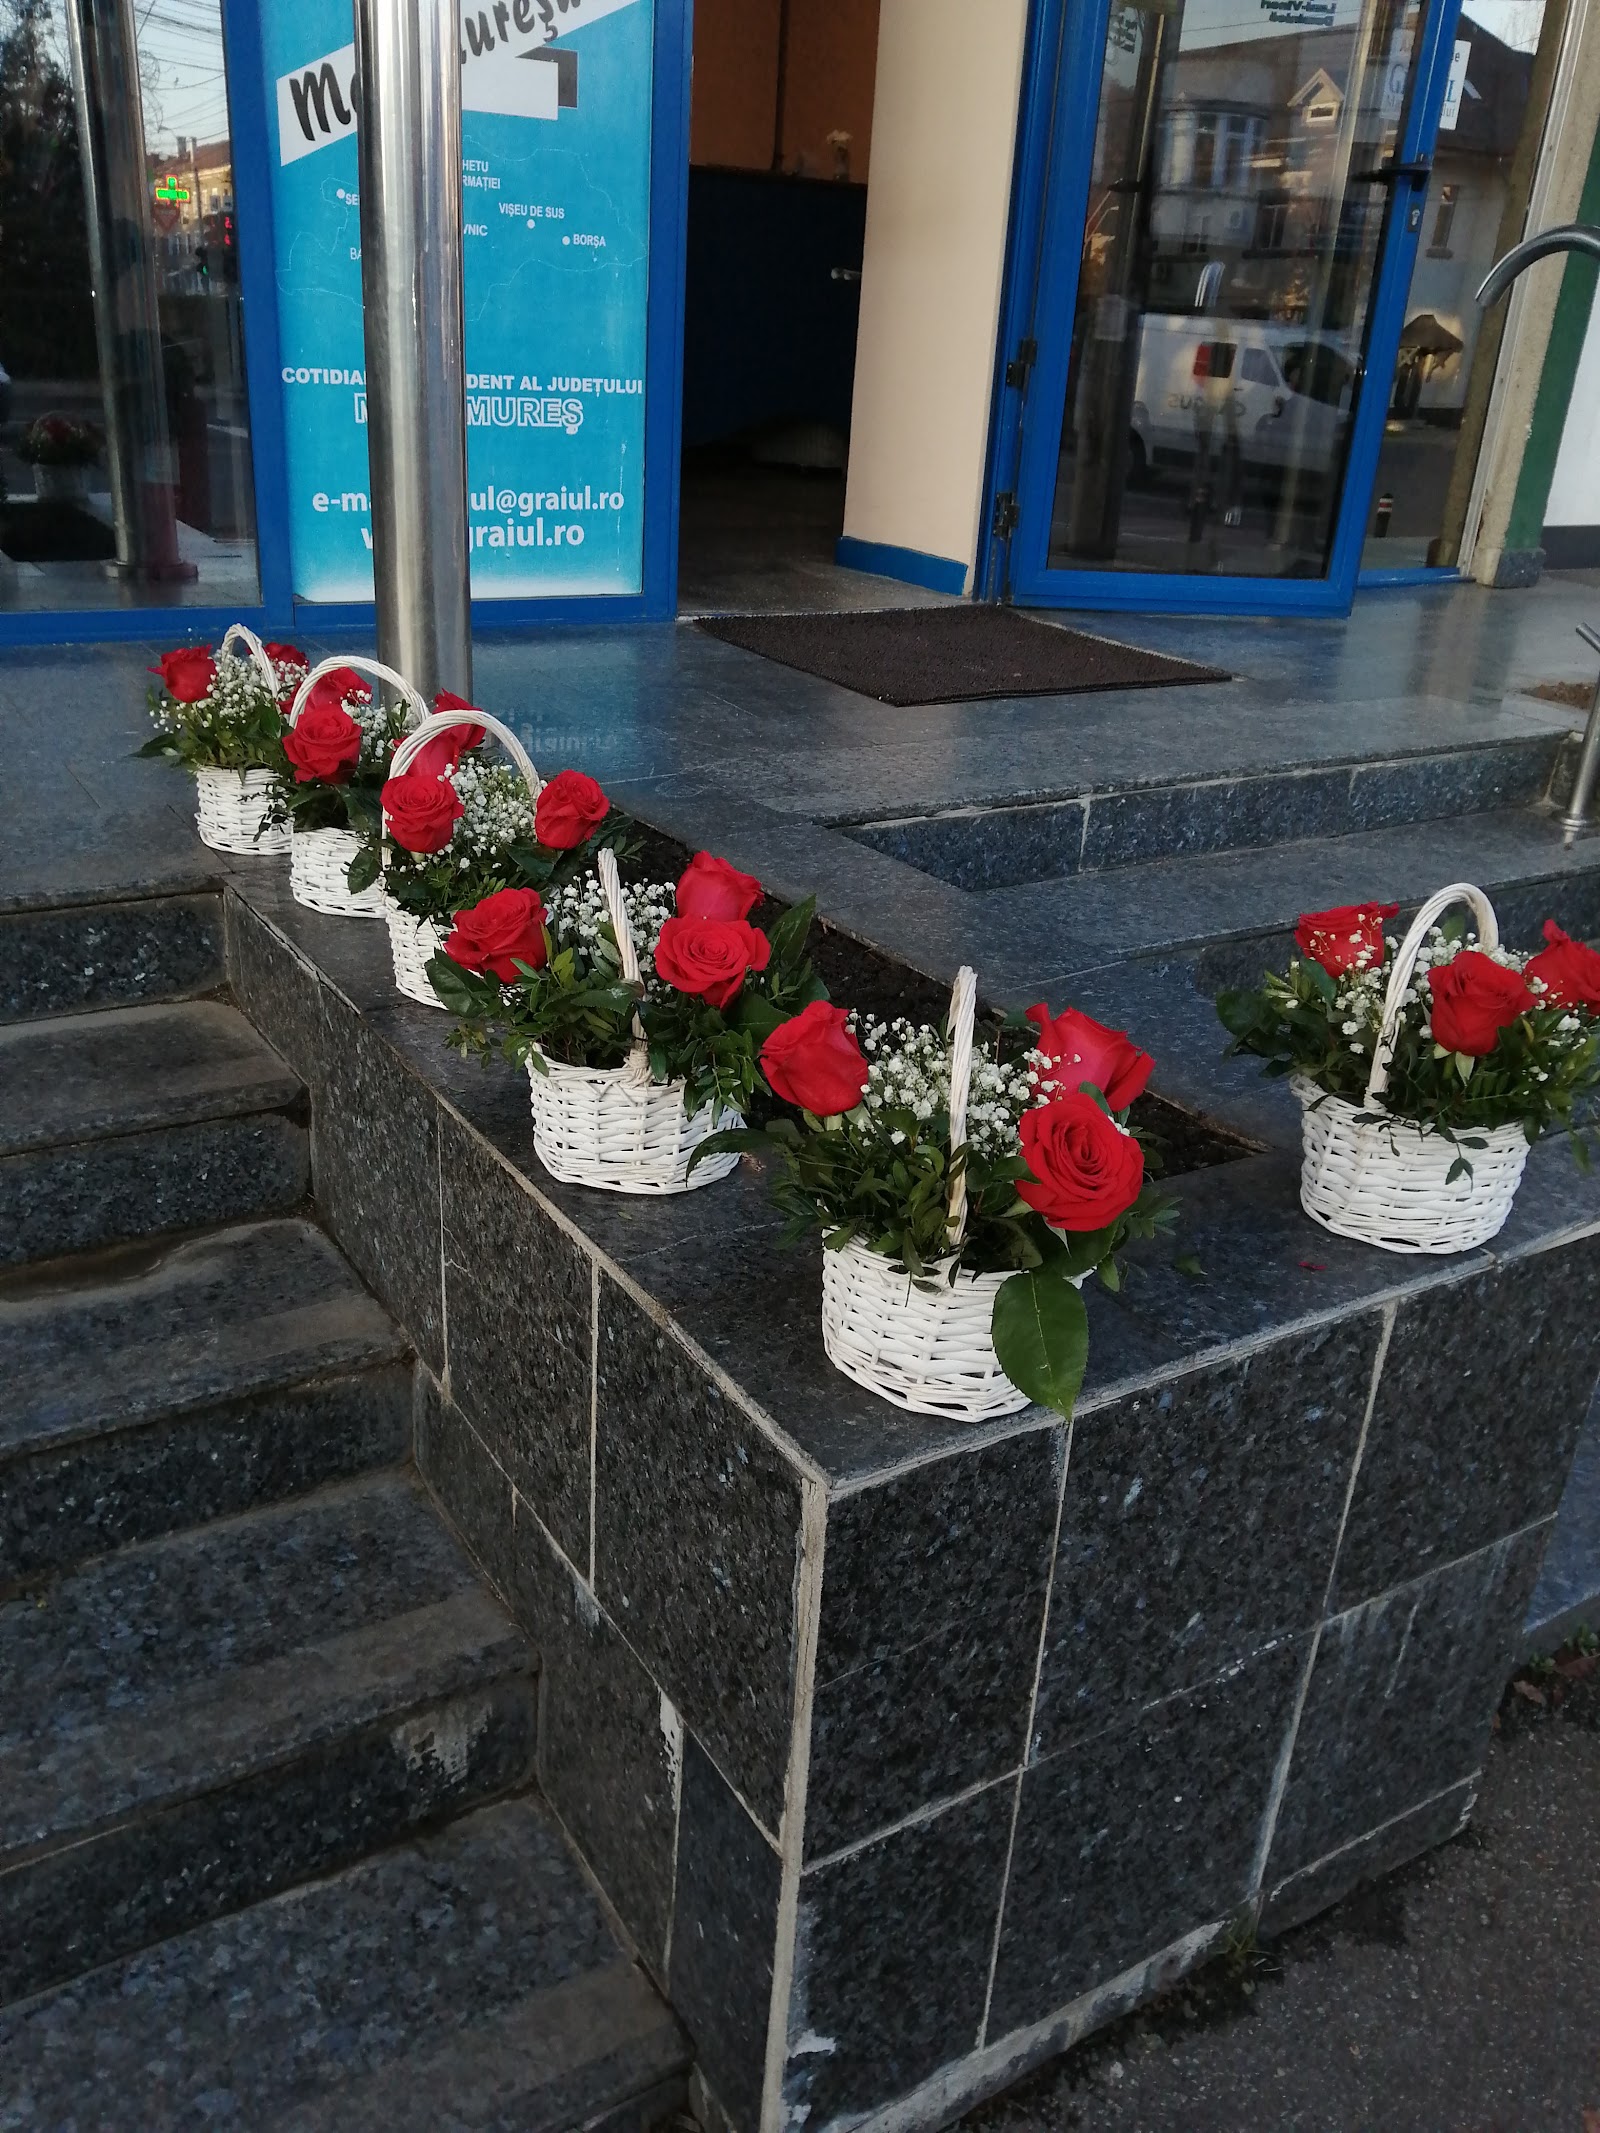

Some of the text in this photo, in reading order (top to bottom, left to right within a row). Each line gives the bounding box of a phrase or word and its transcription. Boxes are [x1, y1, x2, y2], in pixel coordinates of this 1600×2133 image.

[462, 159, 489, 173] HETU
[529, 205, 543, 217] DE
[545, 207, 565, 219] SUS
[463, 224, 488, 236] VNIC
[281, 367, 367, 385] COTIDIA
[466, 373, 514, 391] DENT
[519, 375, 543, 391] AL
[312, 485, 625, 517] e-m ul@graiul.ro
